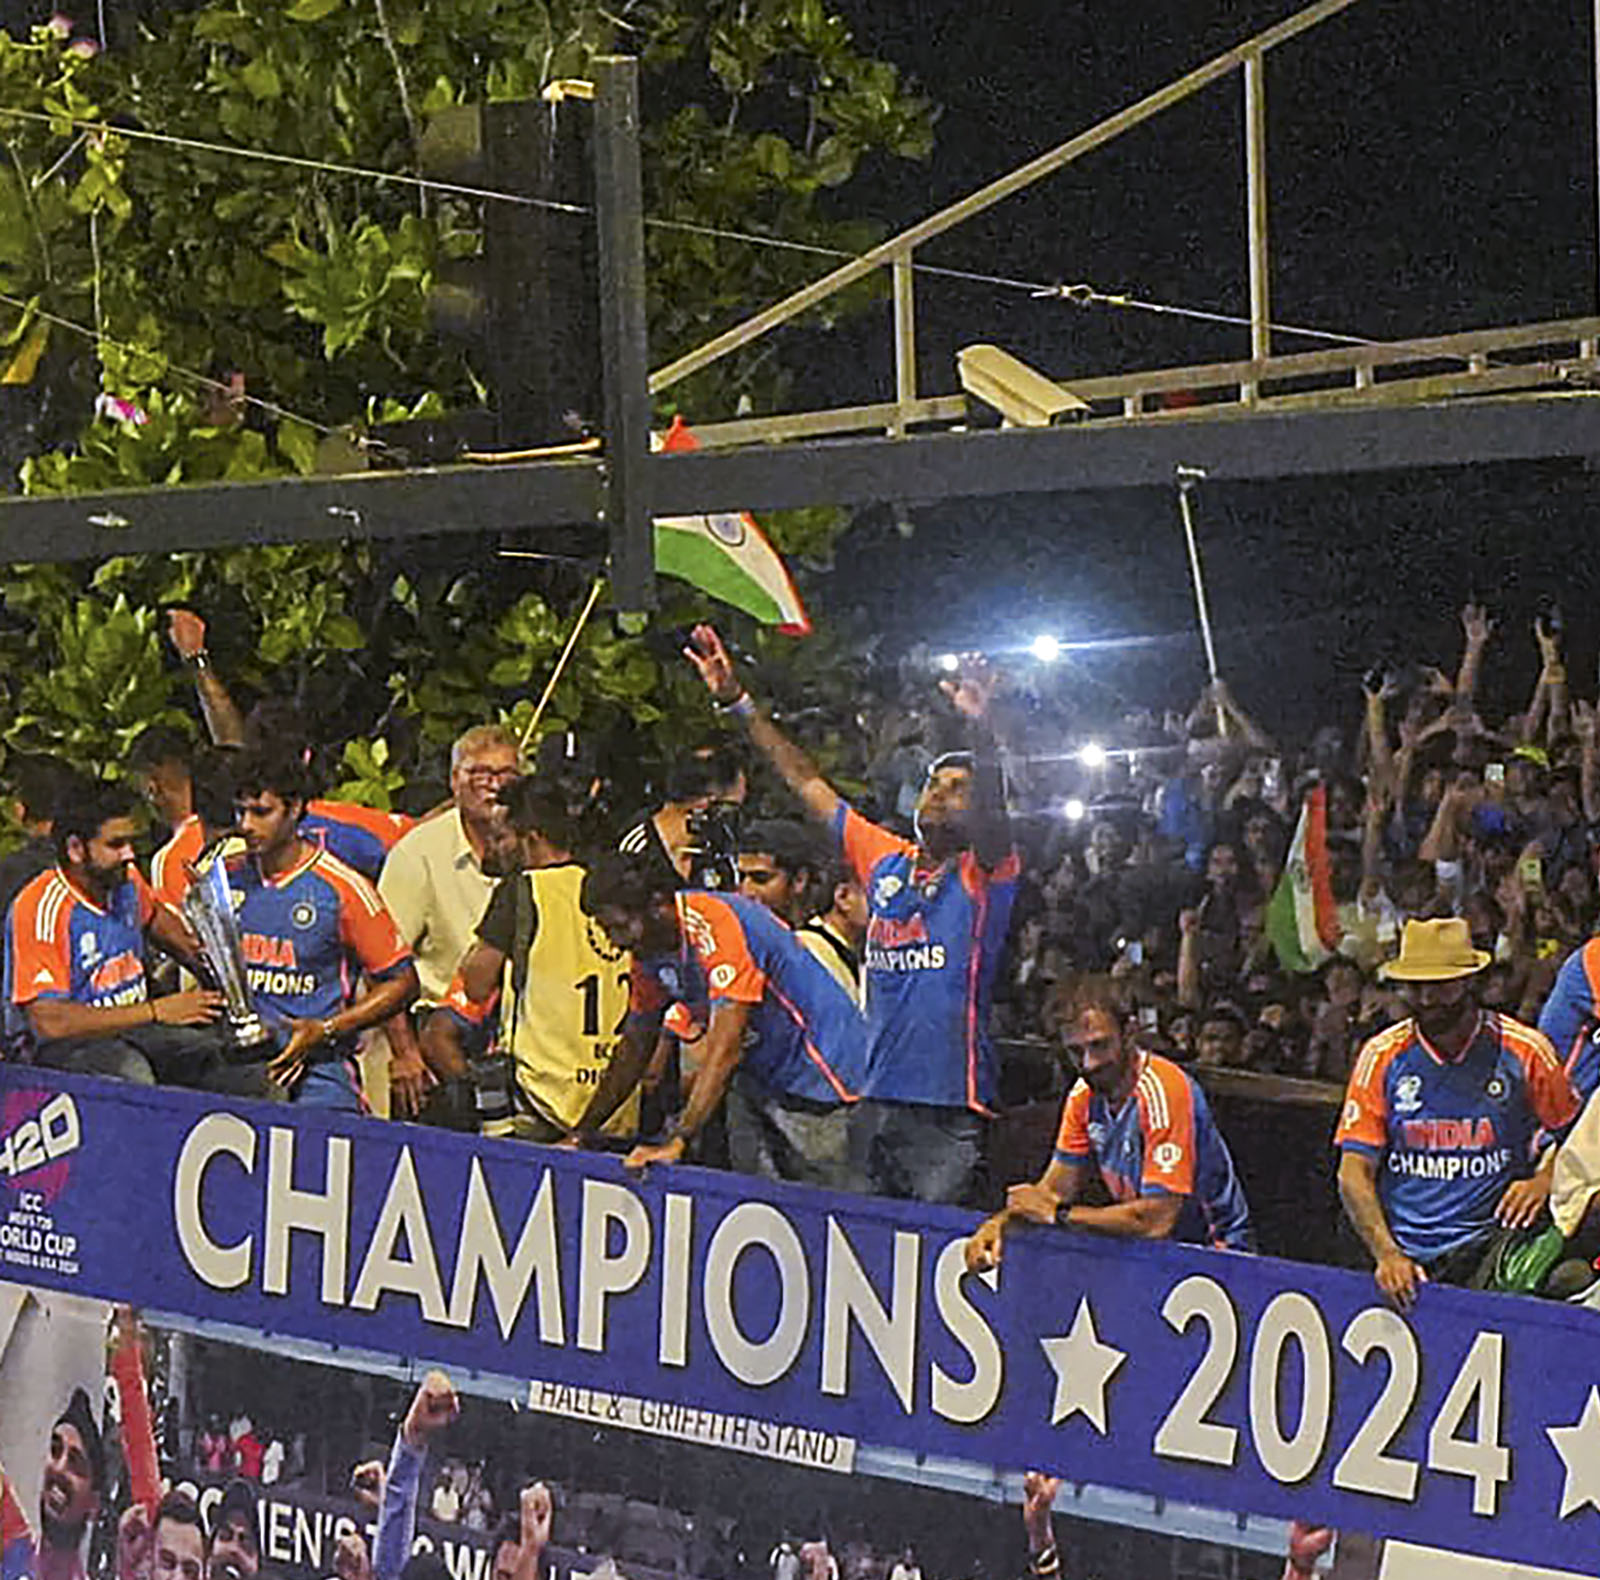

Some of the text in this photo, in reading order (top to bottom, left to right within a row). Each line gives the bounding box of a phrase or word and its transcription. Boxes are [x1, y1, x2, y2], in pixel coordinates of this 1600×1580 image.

[0, 1224, 42, 1251] ORLD
[172, 1111, 1004, 1424] CHAMPIONS
[1153, 1276, 1510, 1518] 2024
[540, 1382, 841, 1465] HALL & GRIFFITH STAND
